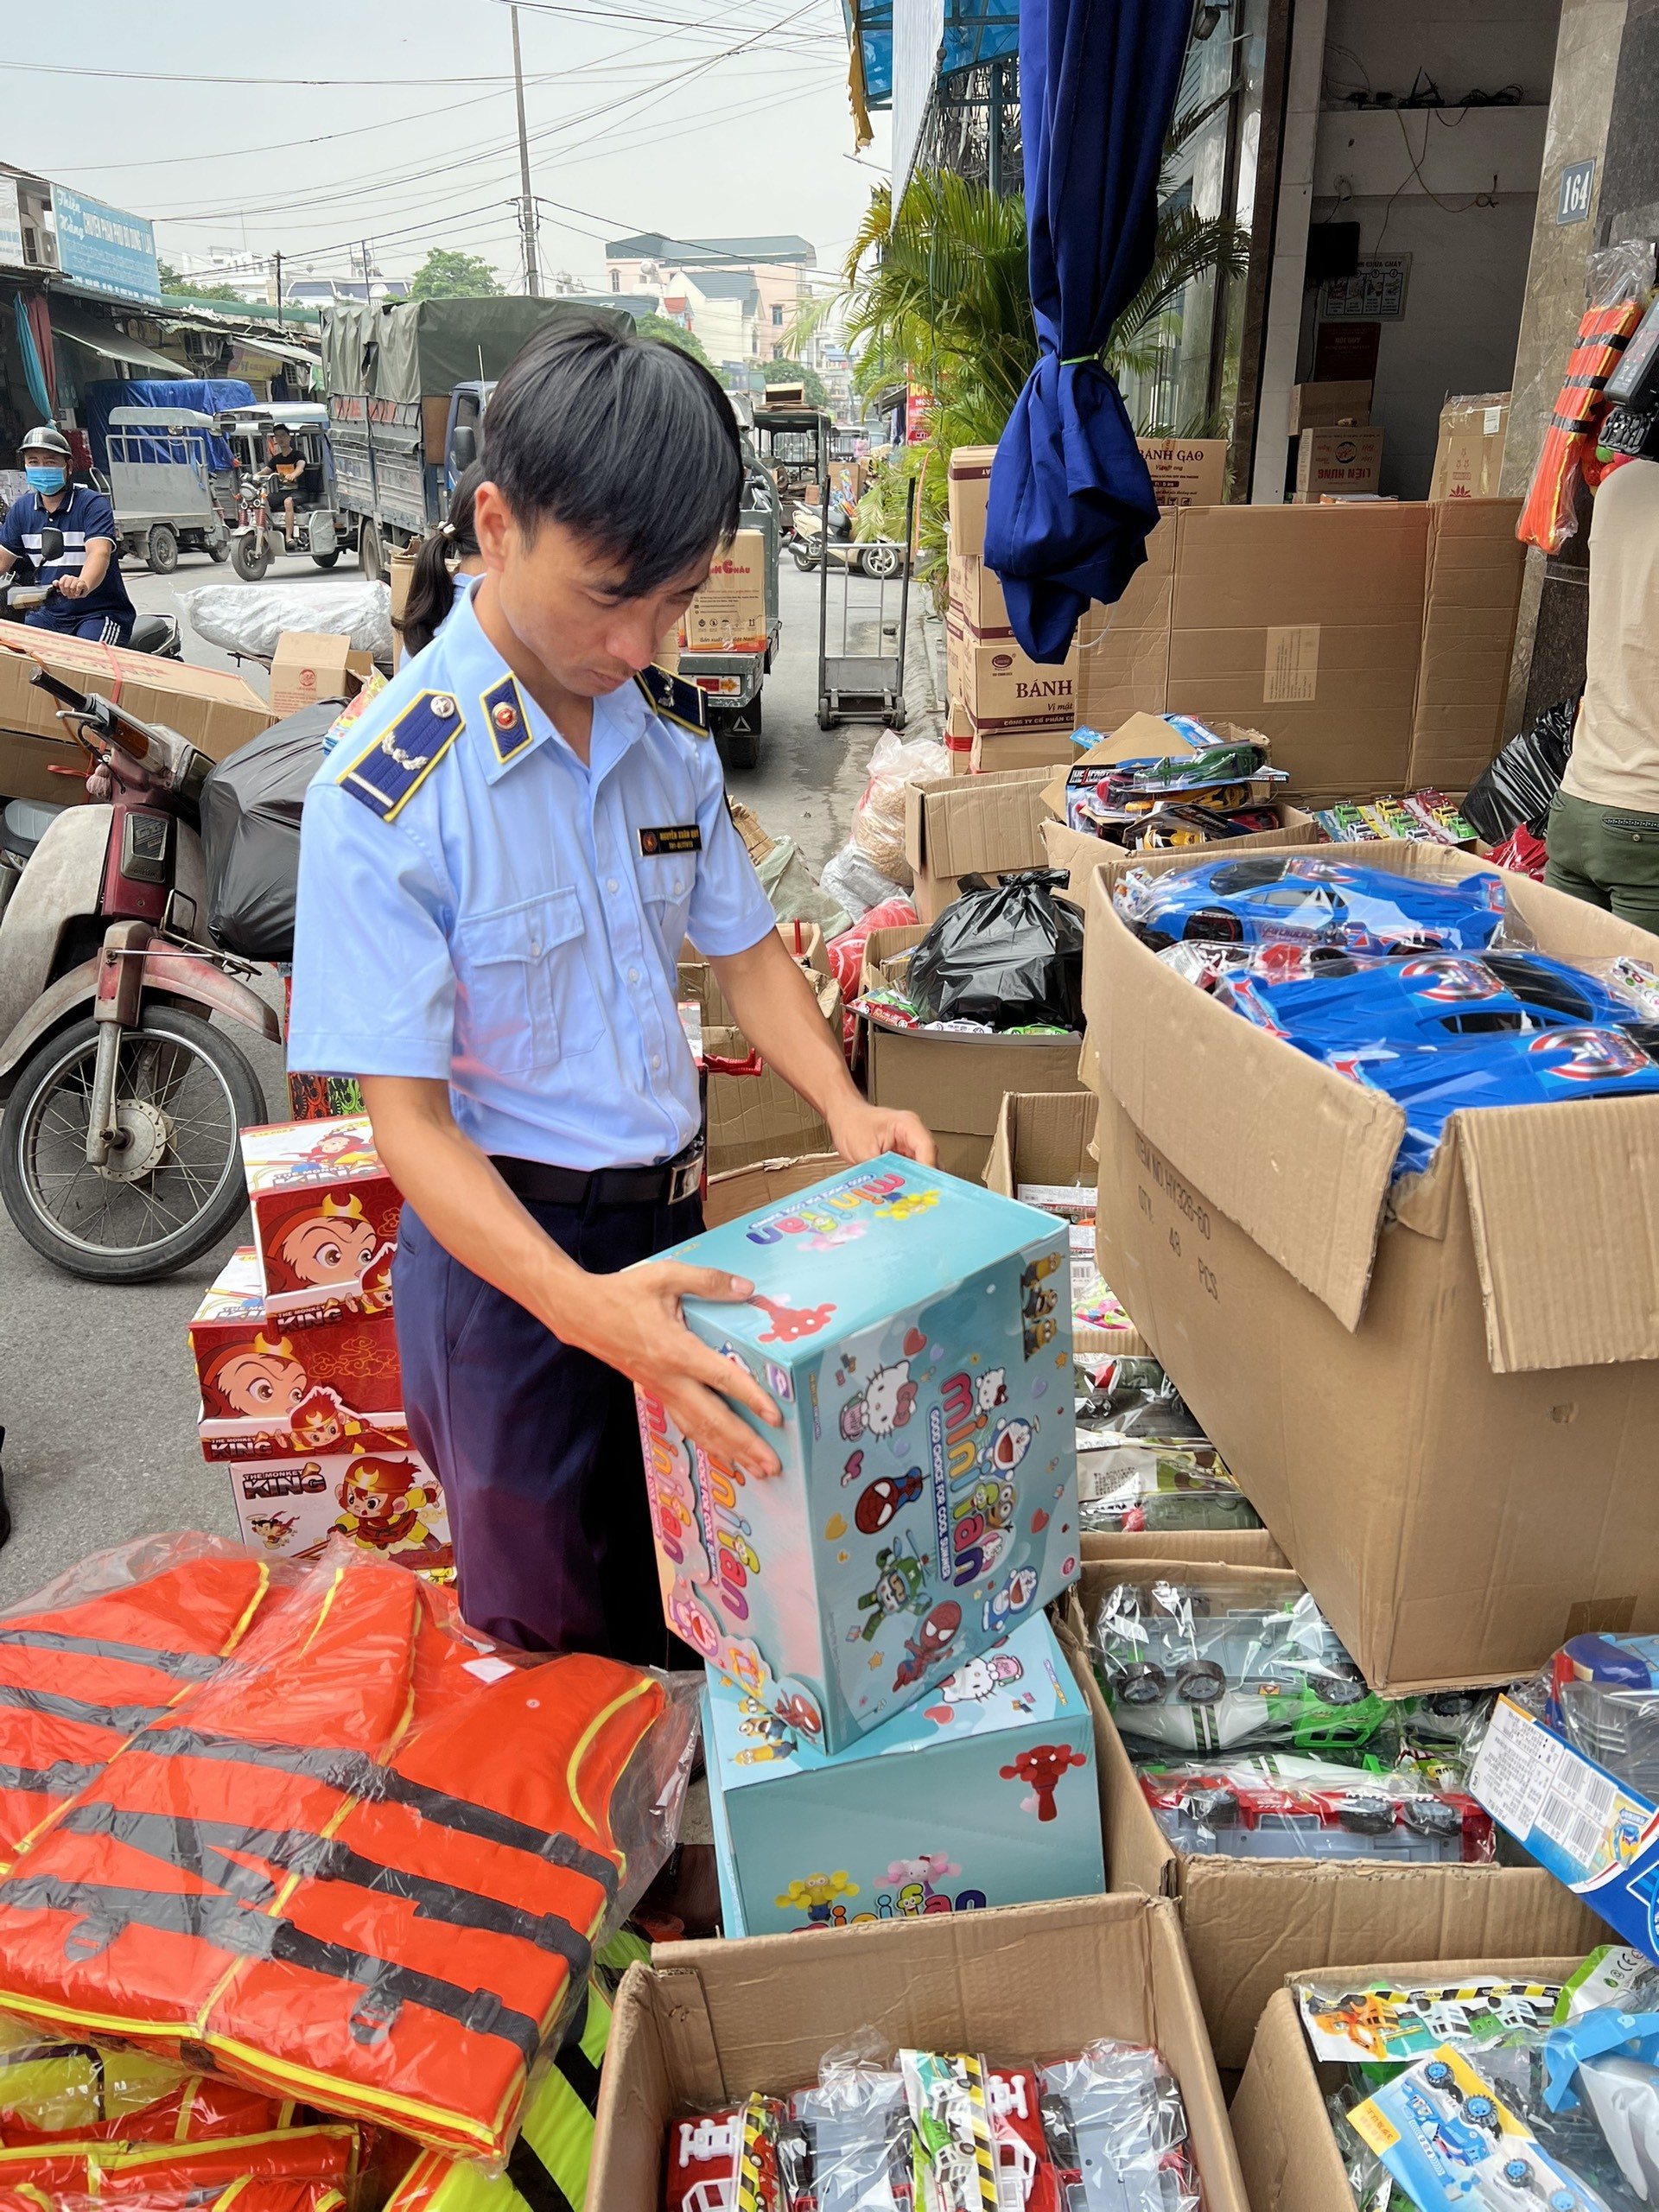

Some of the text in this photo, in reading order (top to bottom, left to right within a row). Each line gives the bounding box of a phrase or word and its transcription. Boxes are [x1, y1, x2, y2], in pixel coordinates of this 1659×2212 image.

[1562, 171, 1590, 214] 164
[1177, 450, 1205, 463] GẠO
[1015, 679, 1073, 699] BÁNH
[1047, 702, 1073, 712] Vị mật
[1004, 717, 1023, 726] CÔNG
[273, 1166, 381, 1191] KING
[274, 1165, 352, 1179] THE MONKEY
[213, 1309, 266, 1325] KI
[294, 1304, 326, 1315] MONKEY
[276, 1307, 343, 1335] KING
[931, 1408, 941, 1443] GOOD
[210, 1440, 274, 1459] KING
[264, 1469, 303, 1478] MONKEY
[932, 1444, 944, 1484] CHOICE
[243, 1473, 327, 1500] KING
[935, 1484, 946, 1506] FOR
[937, 1507, 949, 1537] COOL
[708, 1454, 760, 1621] inifan
